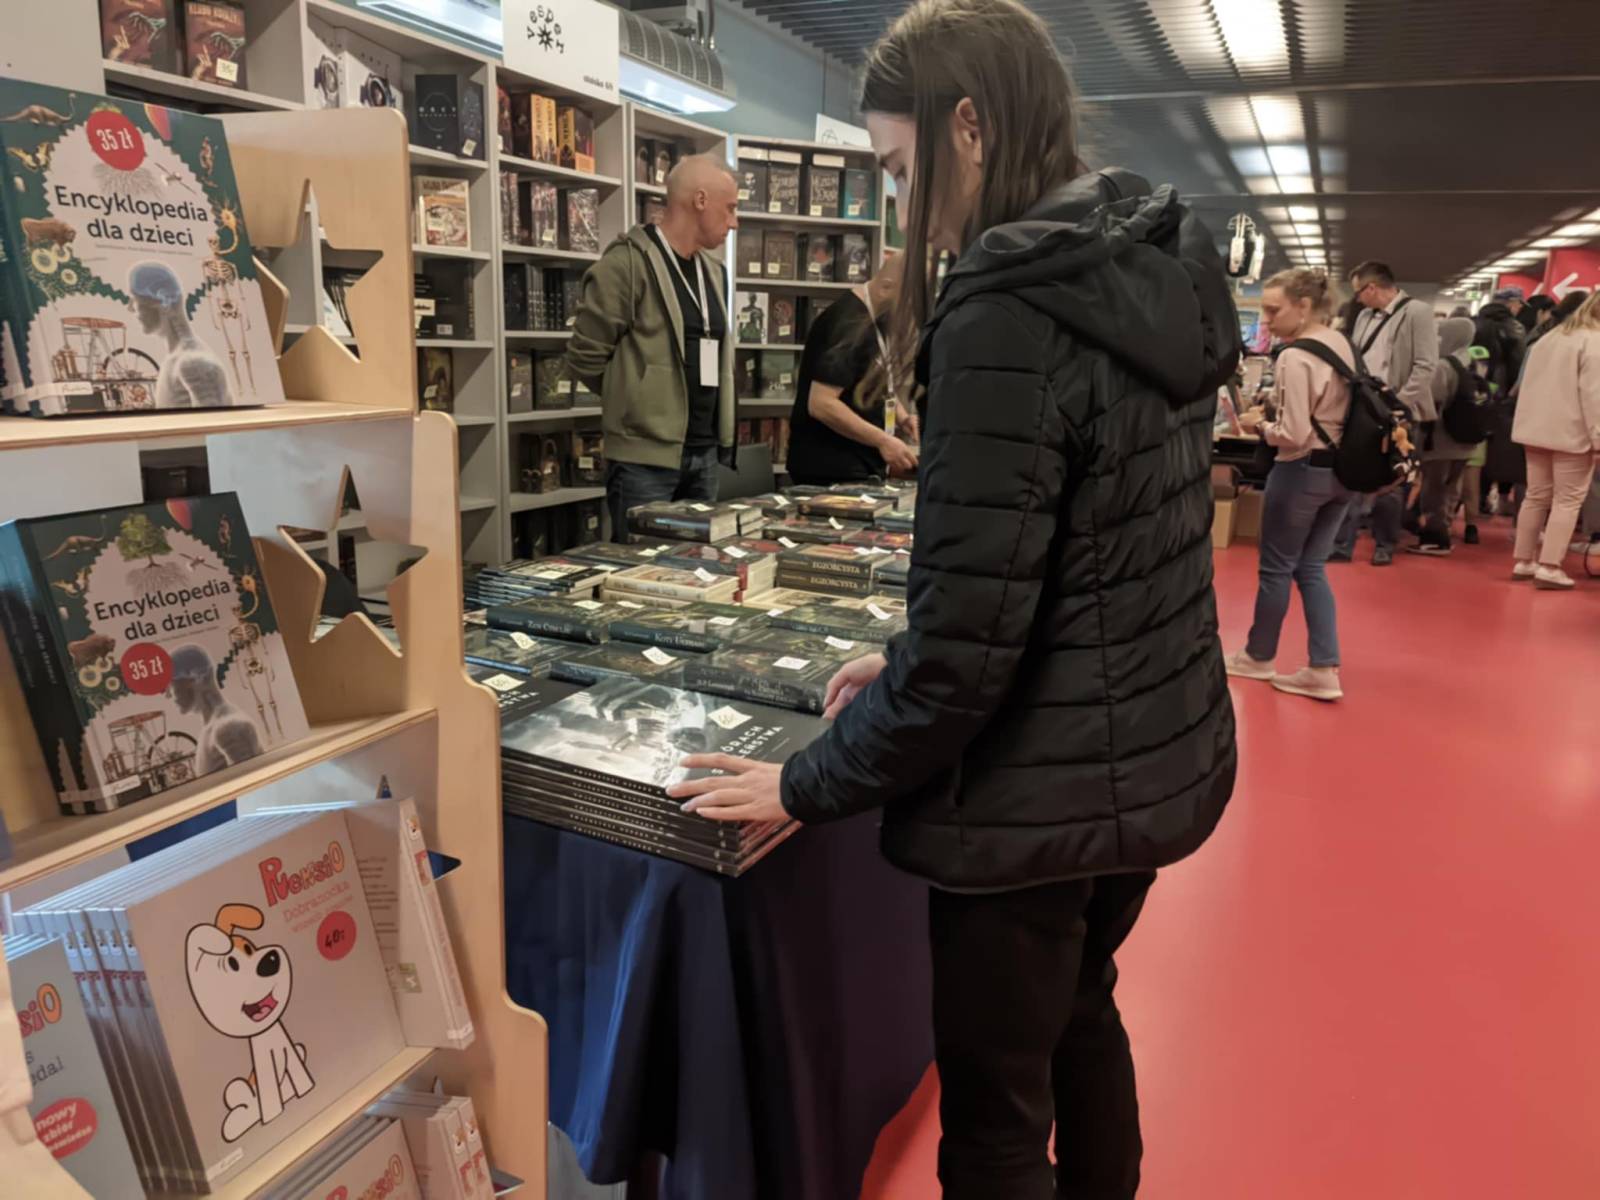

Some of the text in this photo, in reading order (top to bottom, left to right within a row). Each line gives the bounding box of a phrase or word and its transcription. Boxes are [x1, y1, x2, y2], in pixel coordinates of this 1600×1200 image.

[96, 127, 133, 152] 35 zł
[55, 185, 209, 222] Encyklopedia
[86, 219, 194, 247] dla dzieci
[94, 580, 231, 622] Encyklopedia
[124, 604, 220, 642] dla dzieci
[128, 654, 164, 682] 35 zł
[36, 1102, 78, 1132] nowy
